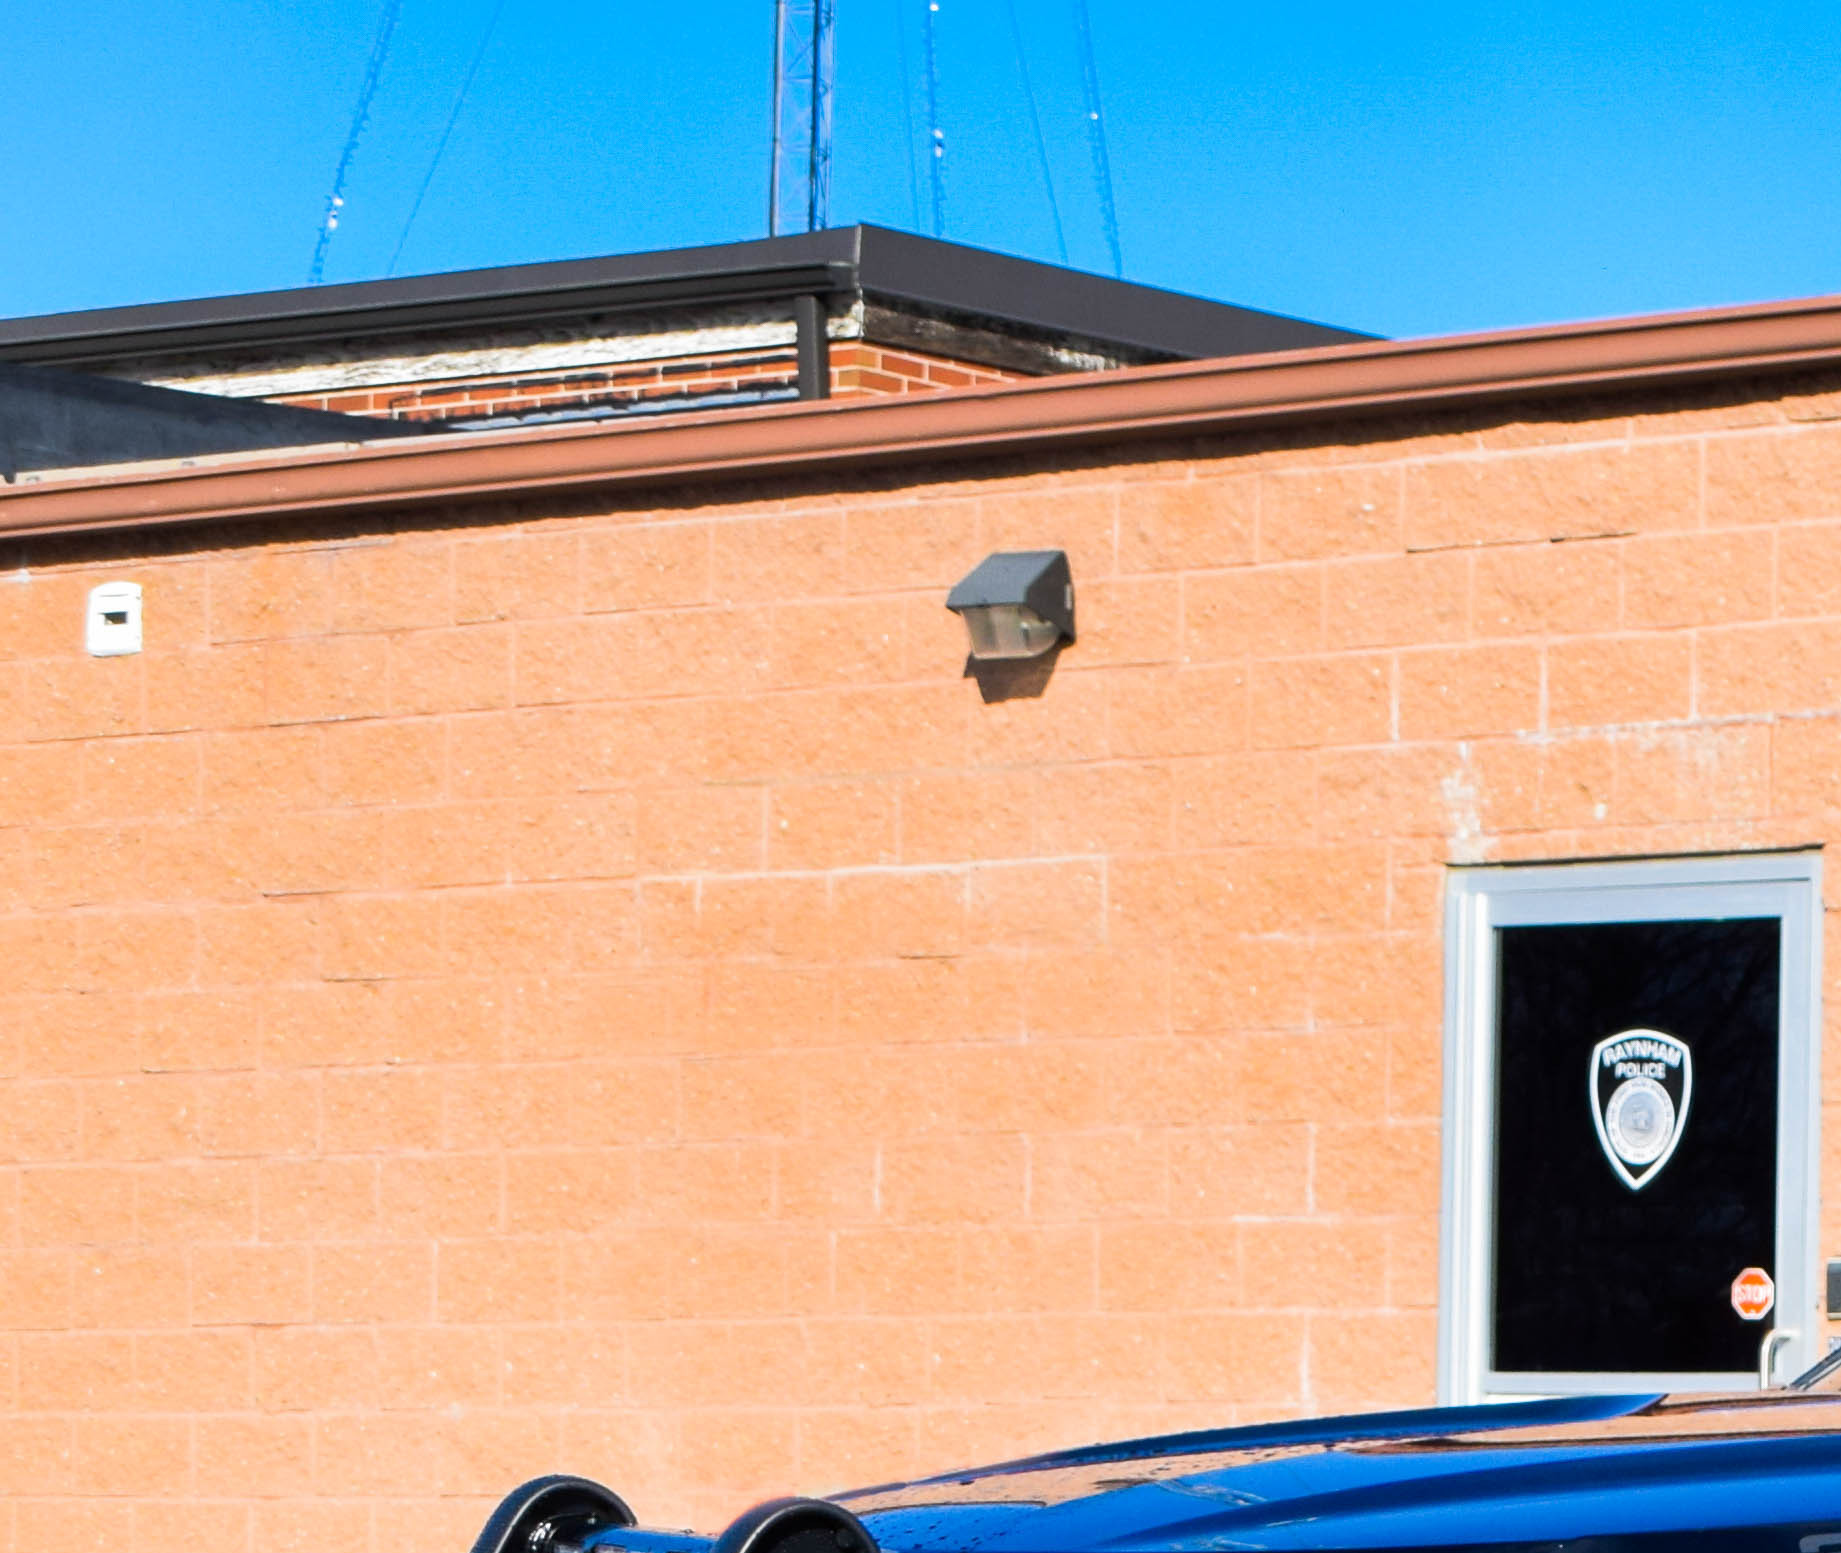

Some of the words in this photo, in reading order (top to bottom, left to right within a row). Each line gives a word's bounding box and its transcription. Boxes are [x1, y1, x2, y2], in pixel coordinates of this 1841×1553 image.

[1602, 1039, 1682, 1067] RAYNHAM
[1614, 1062, 1666, 1079] POLICE
[1734, 1284, 1773, 1305] STOP
